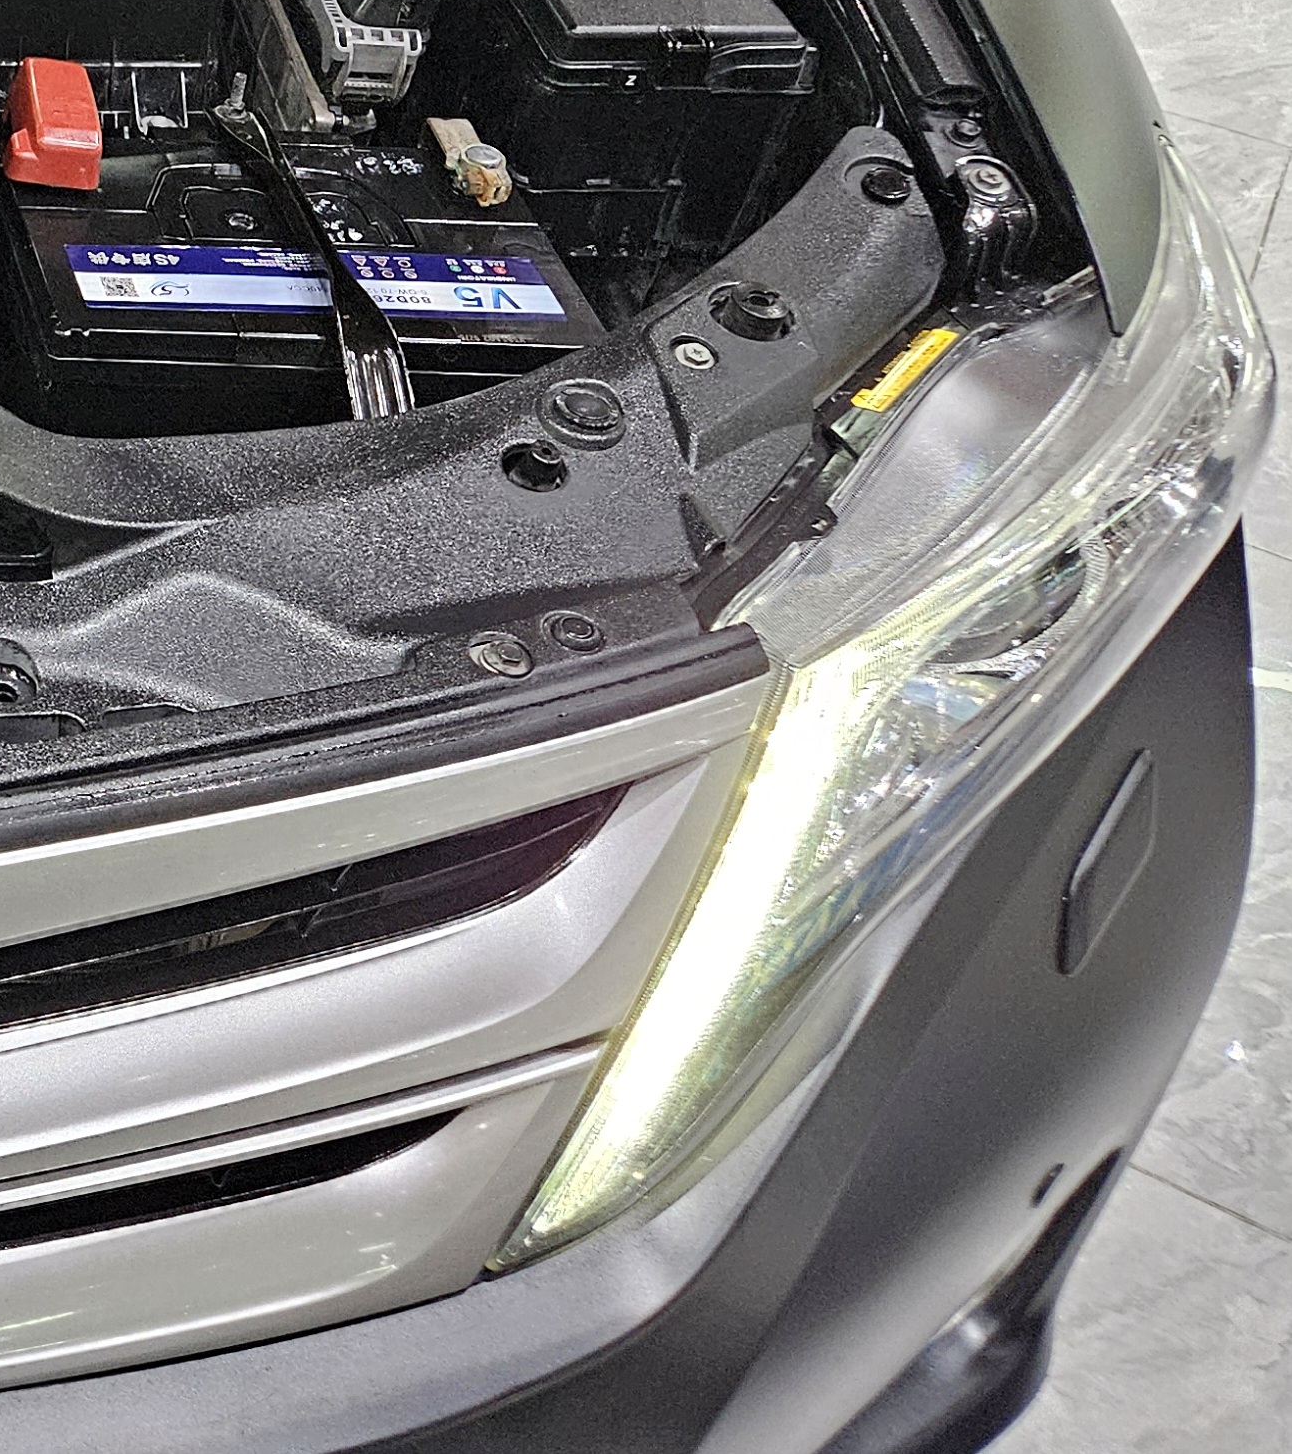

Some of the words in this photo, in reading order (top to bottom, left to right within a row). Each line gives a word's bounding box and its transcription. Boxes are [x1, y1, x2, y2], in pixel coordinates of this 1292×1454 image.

[88, 251, 180, 266] 4S店专供
[453, 286, 522, 310] V5
